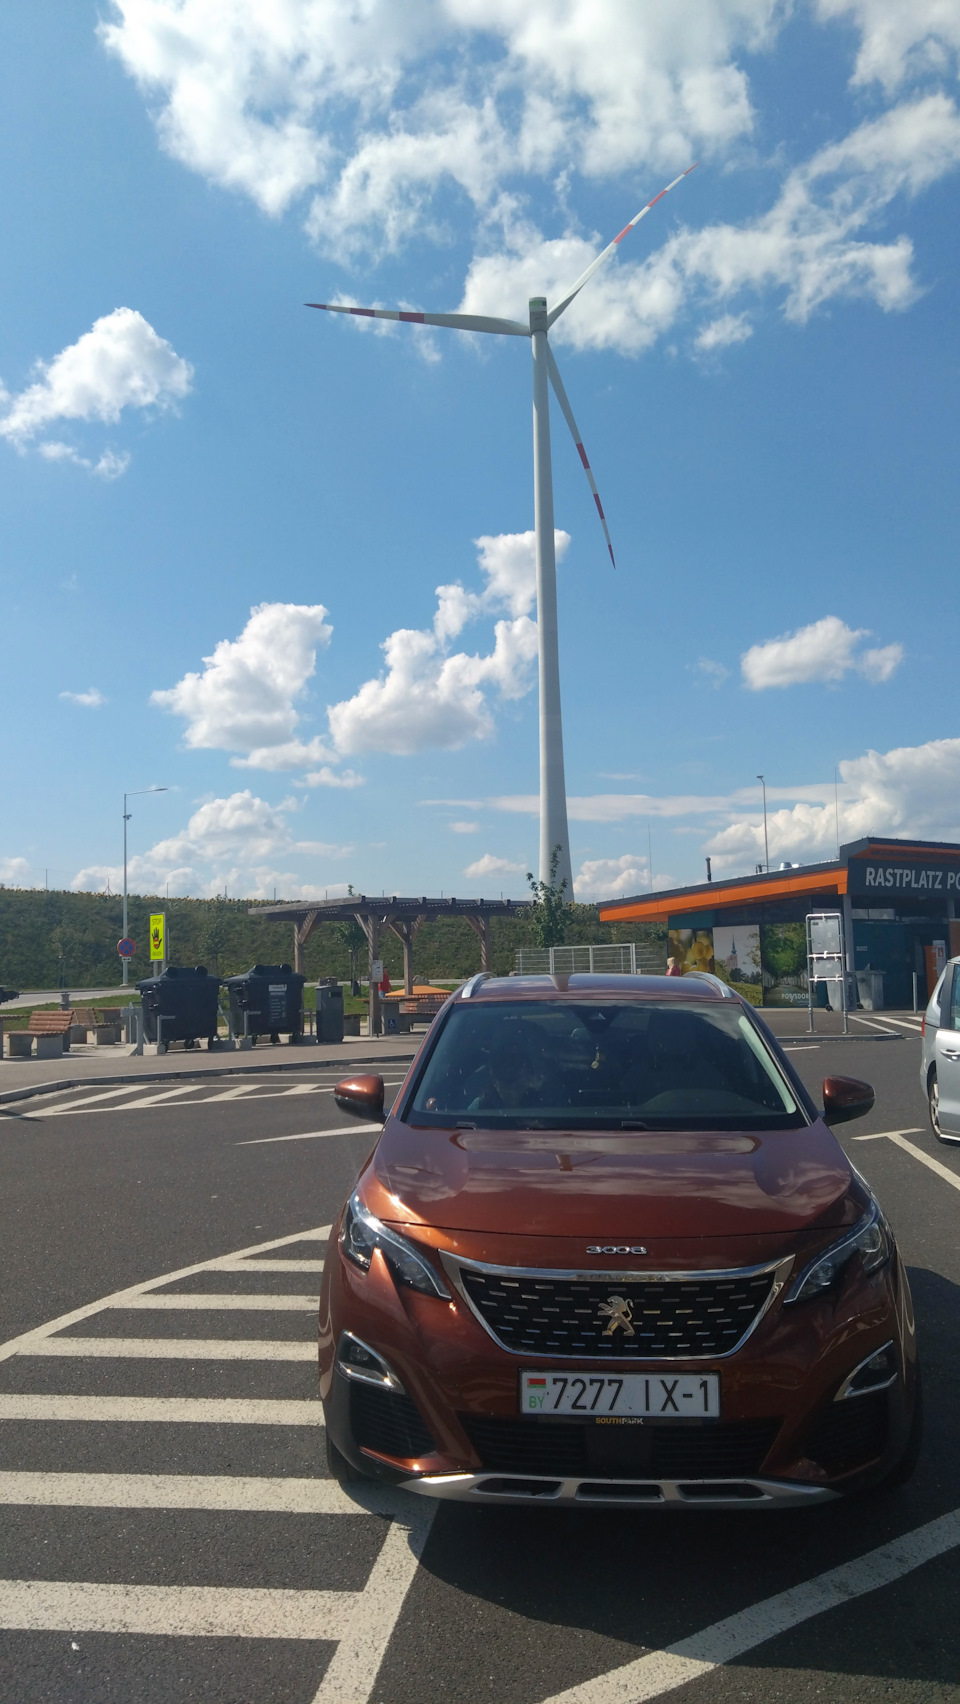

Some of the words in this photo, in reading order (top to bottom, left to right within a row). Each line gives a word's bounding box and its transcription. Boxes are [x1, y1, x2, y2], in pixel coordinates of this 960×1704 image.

[865, 867, 943, 889] RASTPLATZ
[586, 1246, 647, 1254] 3008
[528, 1396, 544, 1408] BY
[552, 1378, 624, 1411] 7277
